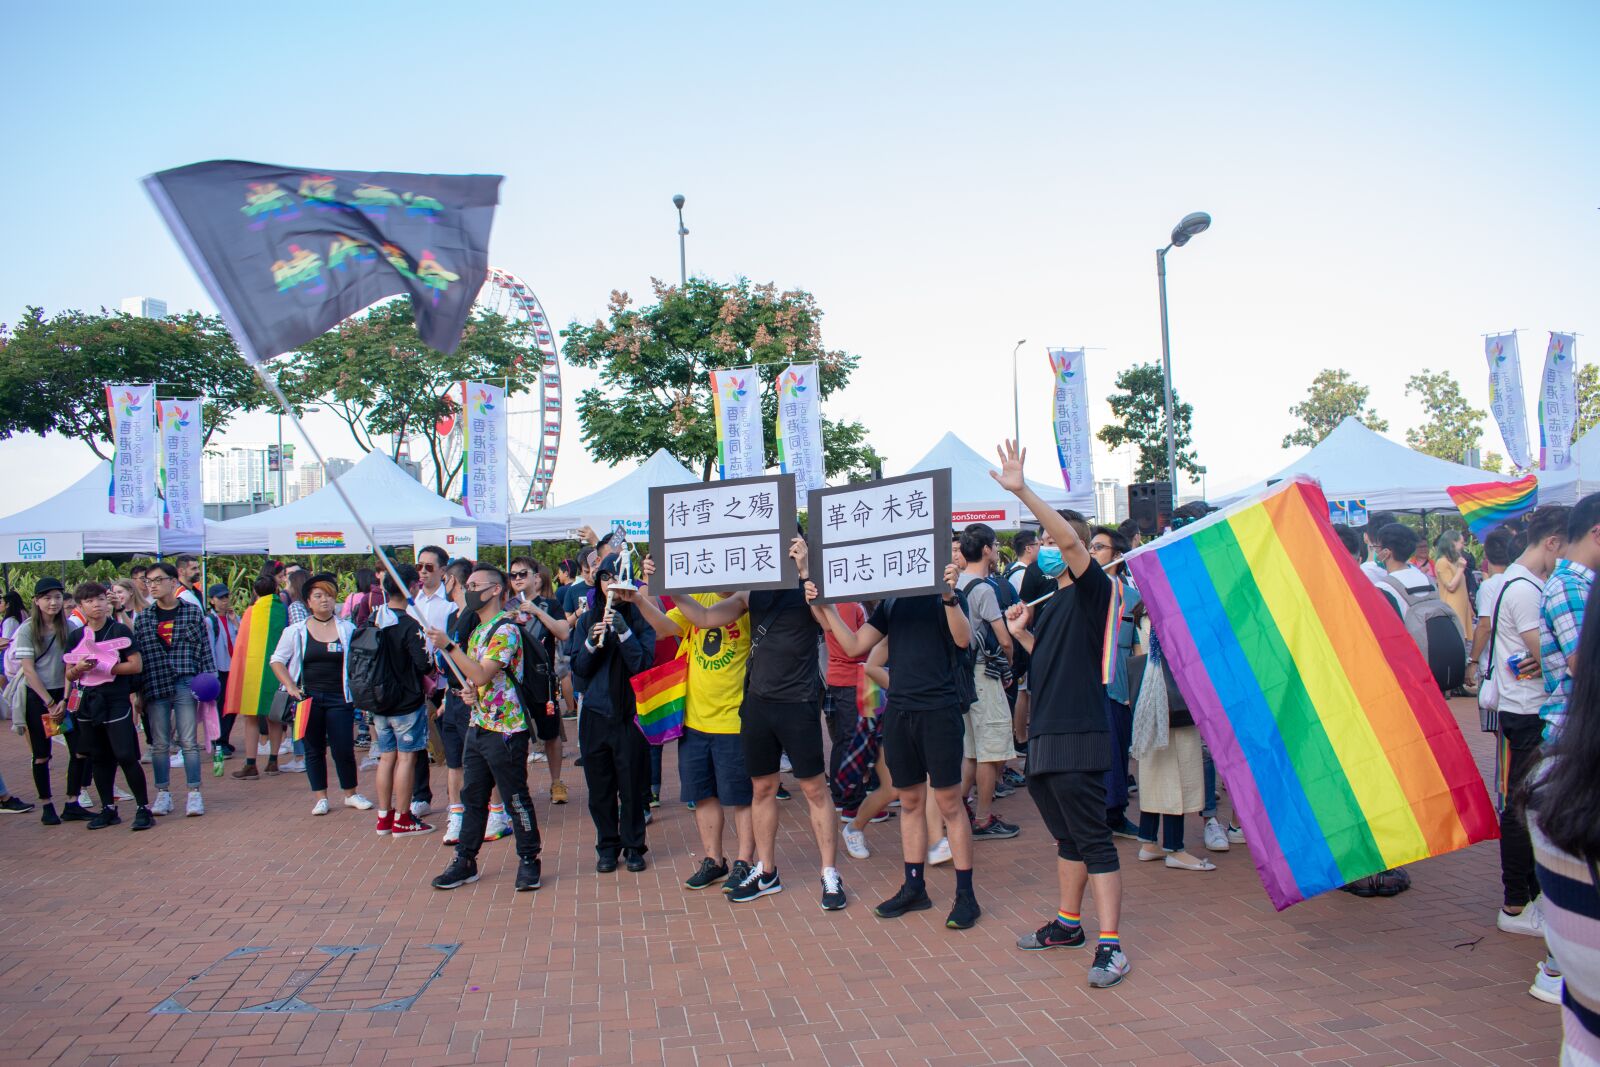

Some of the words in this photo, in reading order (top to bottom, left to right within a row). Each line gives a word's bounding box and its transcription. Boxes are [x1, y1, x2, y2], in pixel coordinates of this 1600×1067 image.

[826, 489, 929, 532] 革命未竟
[626, 519, 642, 528] Gay
[22, 542, 43, 552] AIG
[313, 536, 338, 545] Fidelity
[669, 543, 776, 577] 同志同哀
[828, 546, 931, 585] 同志同路
